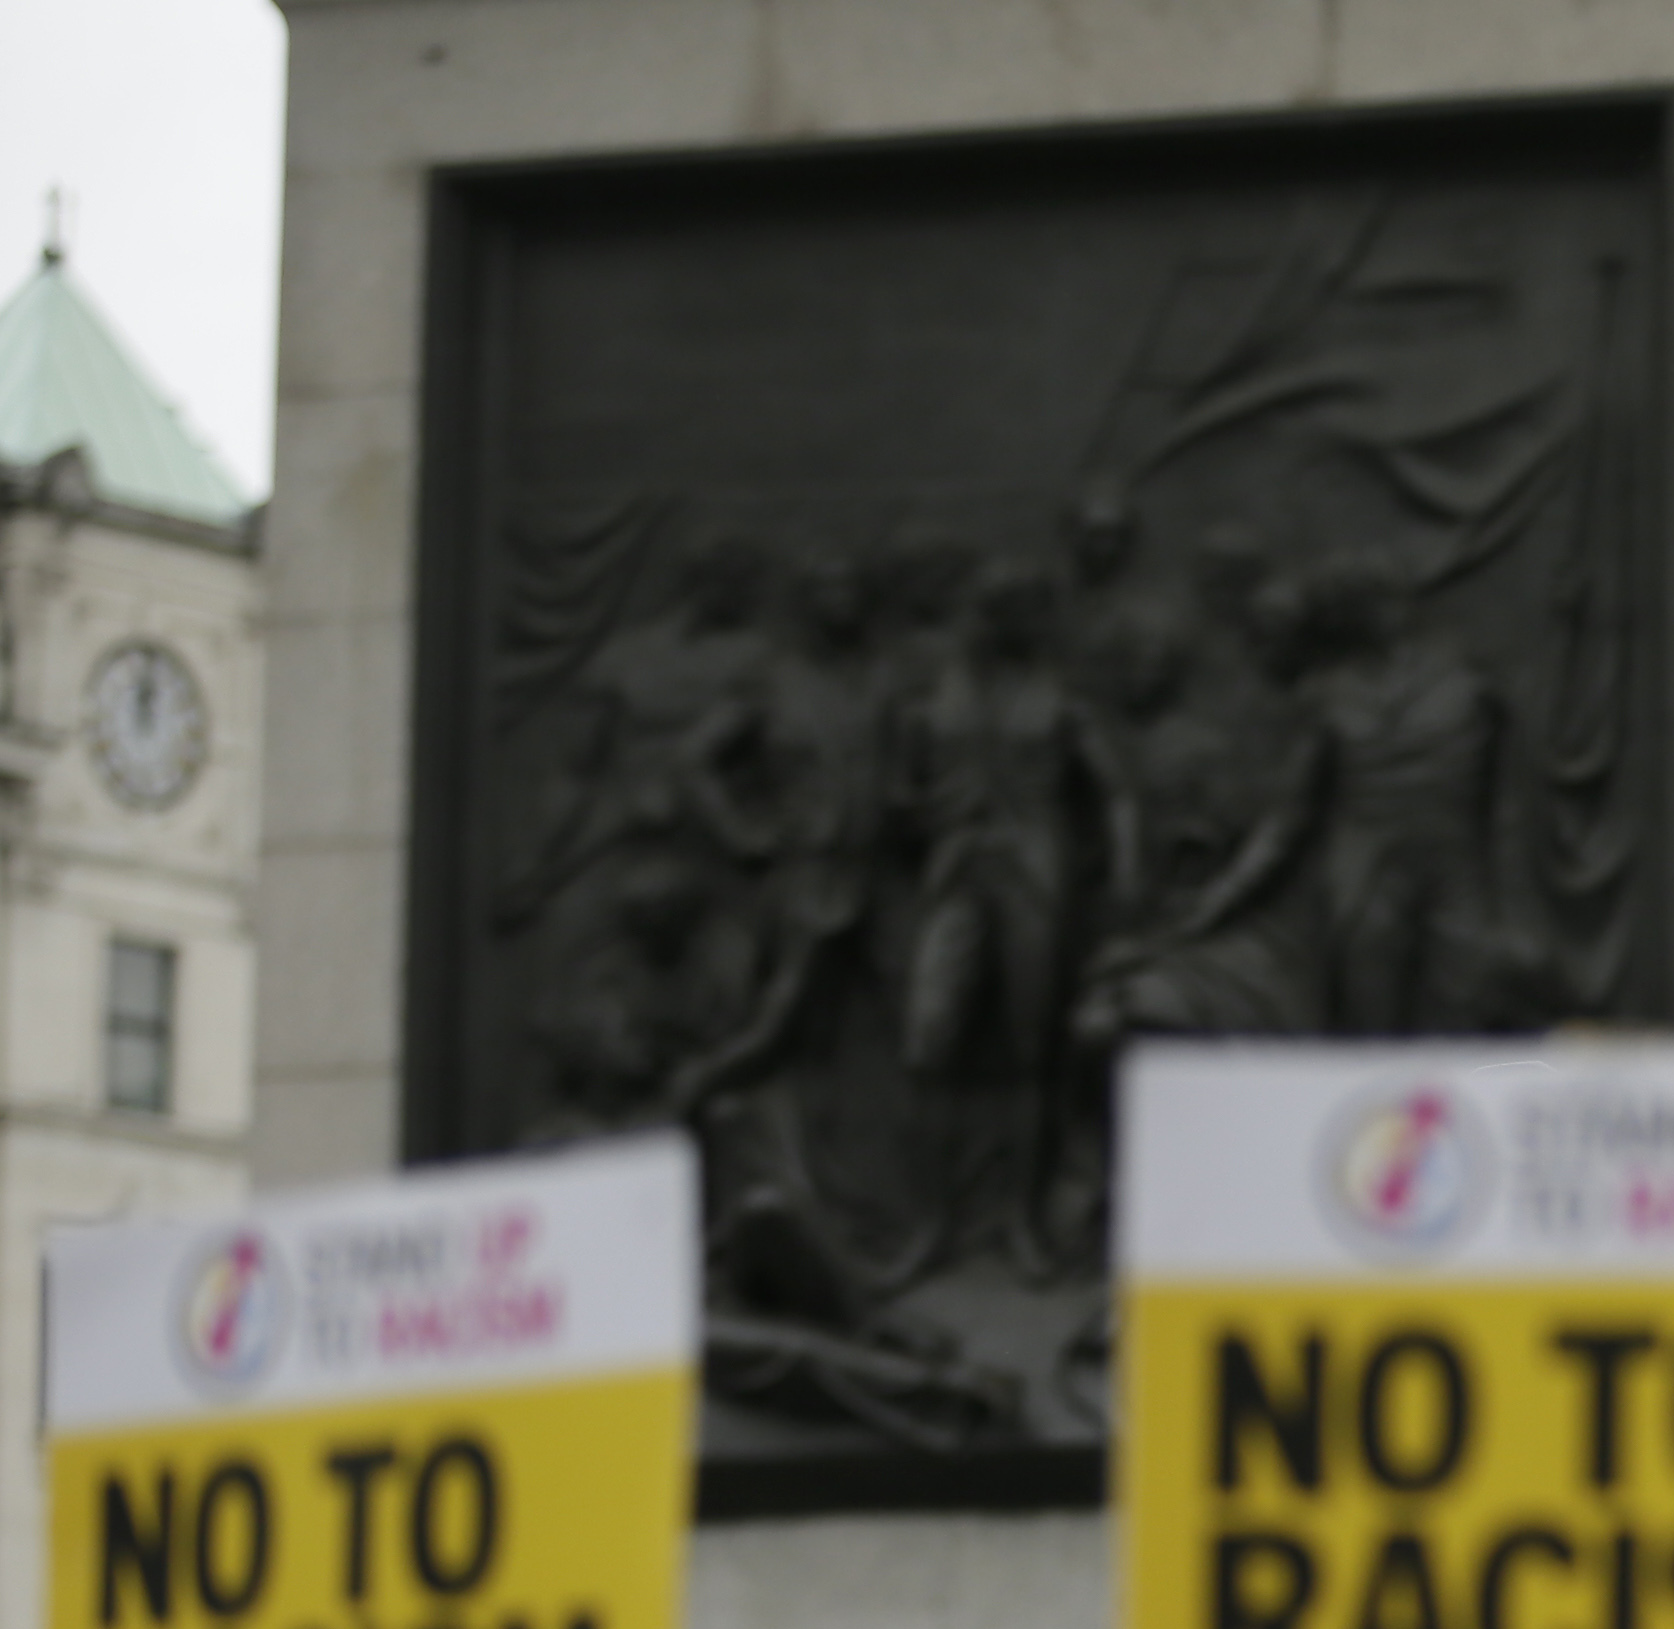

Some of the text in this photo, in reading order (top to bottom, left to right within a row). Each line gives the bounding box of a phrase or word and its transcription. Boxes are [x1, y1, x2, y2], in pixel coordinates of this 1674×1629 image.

[1212, 1327, 1475, 1493] NO
[99, 1428, 500, 1628] NO TO
